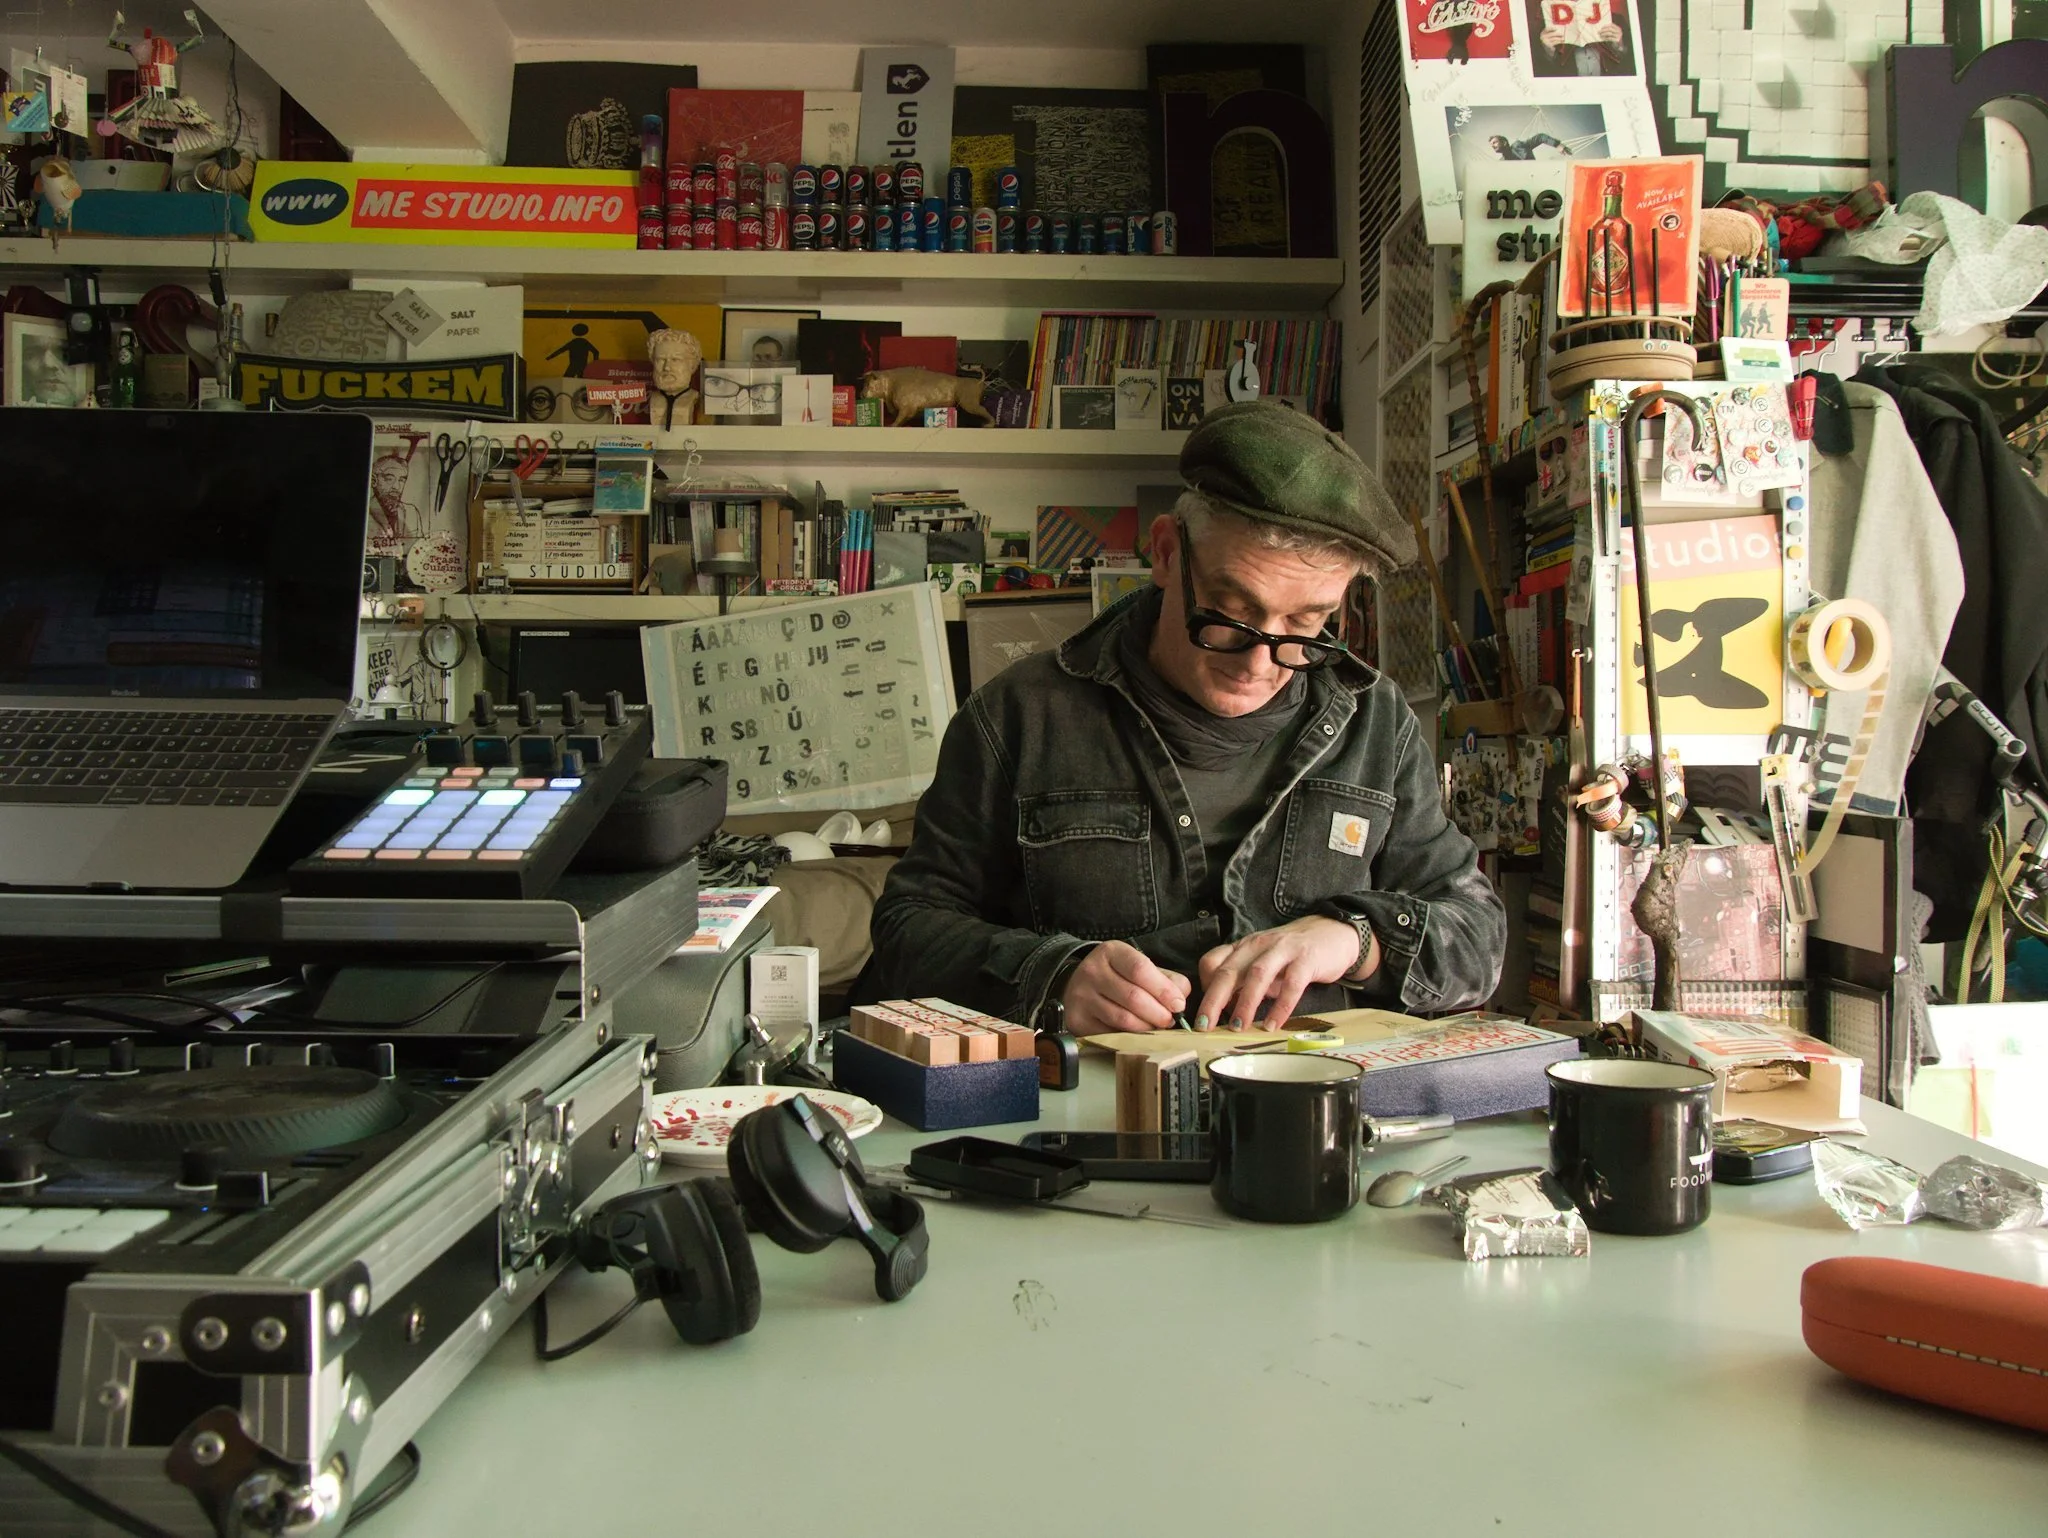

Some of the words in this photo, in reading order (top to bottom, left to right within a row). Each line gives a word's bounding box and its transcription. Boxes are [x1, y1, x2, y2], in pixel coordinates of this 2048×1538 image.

[1551, 4, 1573, 25] D
[1586, 3, 1601, 24] J
[1636, 189, 1686, 209] AVAILABLE
[1644, 188, 1664, 198] NOW
[360, 190, 414, 218] ME
[422, 191, 624, 222] STUDIO.INFO
[1487, 189, 1563, 219] me
[408, 301, 430, 321] SALT
[451, 310, 476, 320] SALT
[391, 311, 419, 336] PAPER
[446, 326, 481, 337] PAPER
[241, 362, 505, 408] FUCKEM
[1171, 383, 1200, 397] ON
[589, 390, 617, 401] LINKSE
[618, 388, 645, 399] HOBBY
[1181, 398, 1190, 410] Y
[1171, 411, 1200, 426] VA
[423, 563, 462, 573] Cuisine
[430, 555, 460, 565] Trash
[530, 565, 616, 579] STUDIO
[771, 578, 815, 586] METROPOLE
[368, 648, 393, 671] KEEP
[745, 657, 759, 677] G
[373, 668, 389, 680] THE
[111, 689, 140, 697] MacBook
[698, 696, 712, 716] K
[1970, 700, 2010, 739] SCOTT
[702, 726, 716, 746] R
[737, 779, 751, 799] 9
